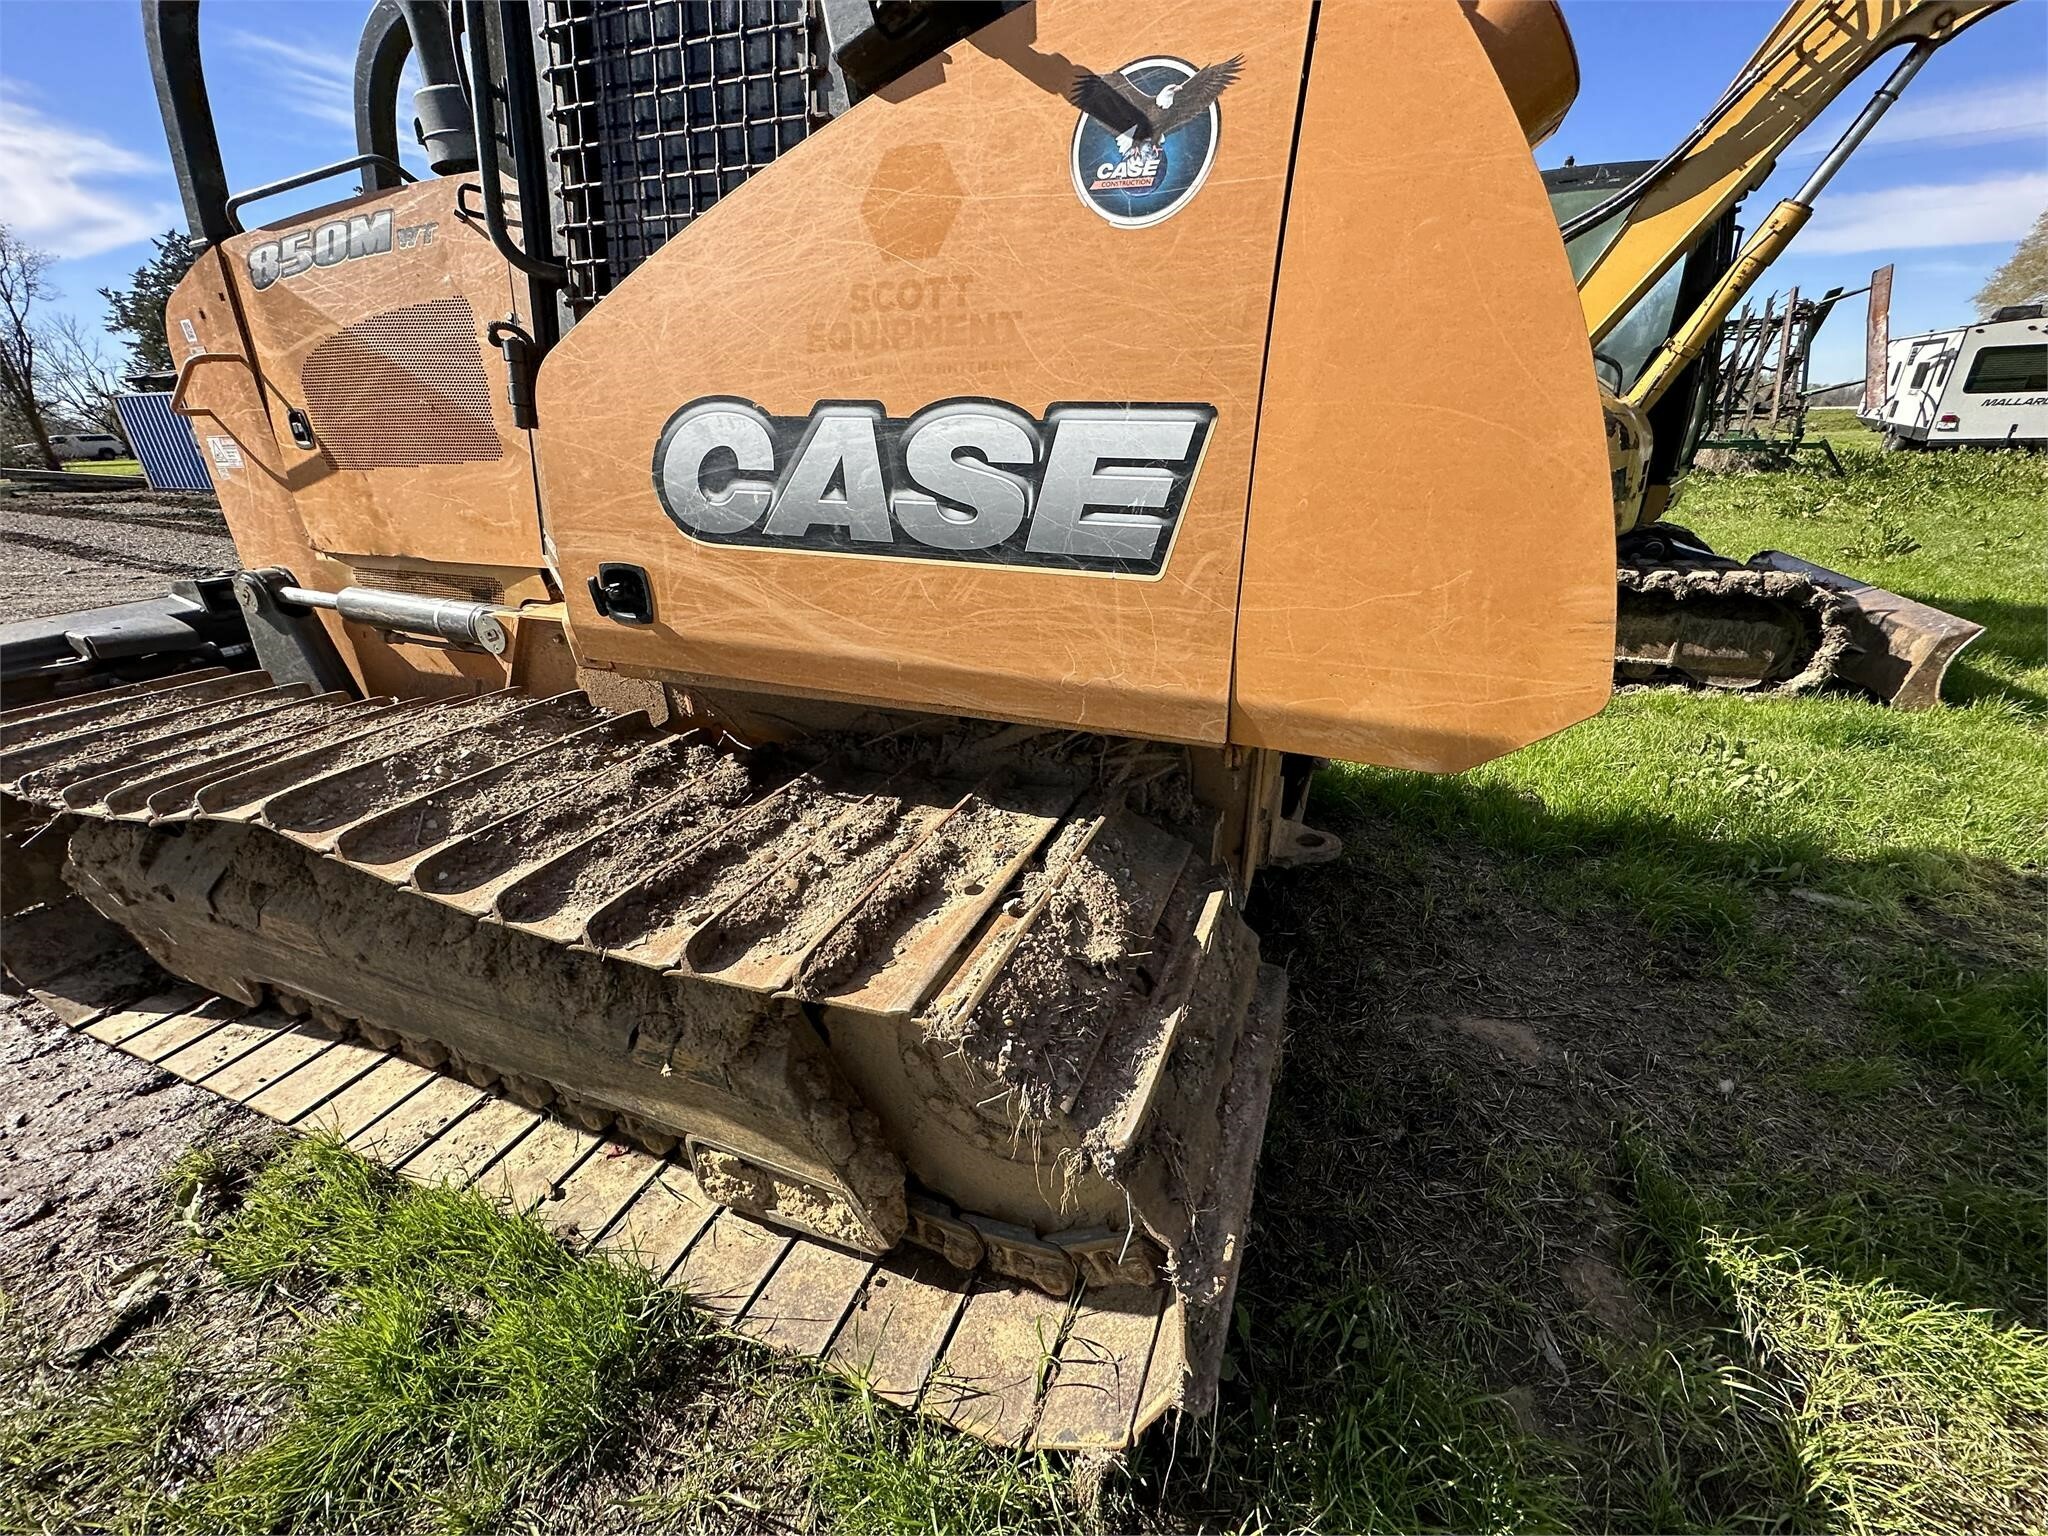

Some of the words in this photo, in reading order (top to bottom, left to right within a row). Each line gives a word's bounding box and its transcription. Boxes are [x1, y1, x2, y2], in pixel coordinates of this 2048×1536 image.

[1096, 159, 1160, 180] CASE
[1101, 179, 1151, 188] CONSTRUCTION
[248, 209, 394, 291] 850M
[397, 221, 439, 250] WT
[850, 274, 973, 314] SCOTT
[806, 310, 1023, 354] EQUIPMENT
[662, 411, 1197, 560] CASE
